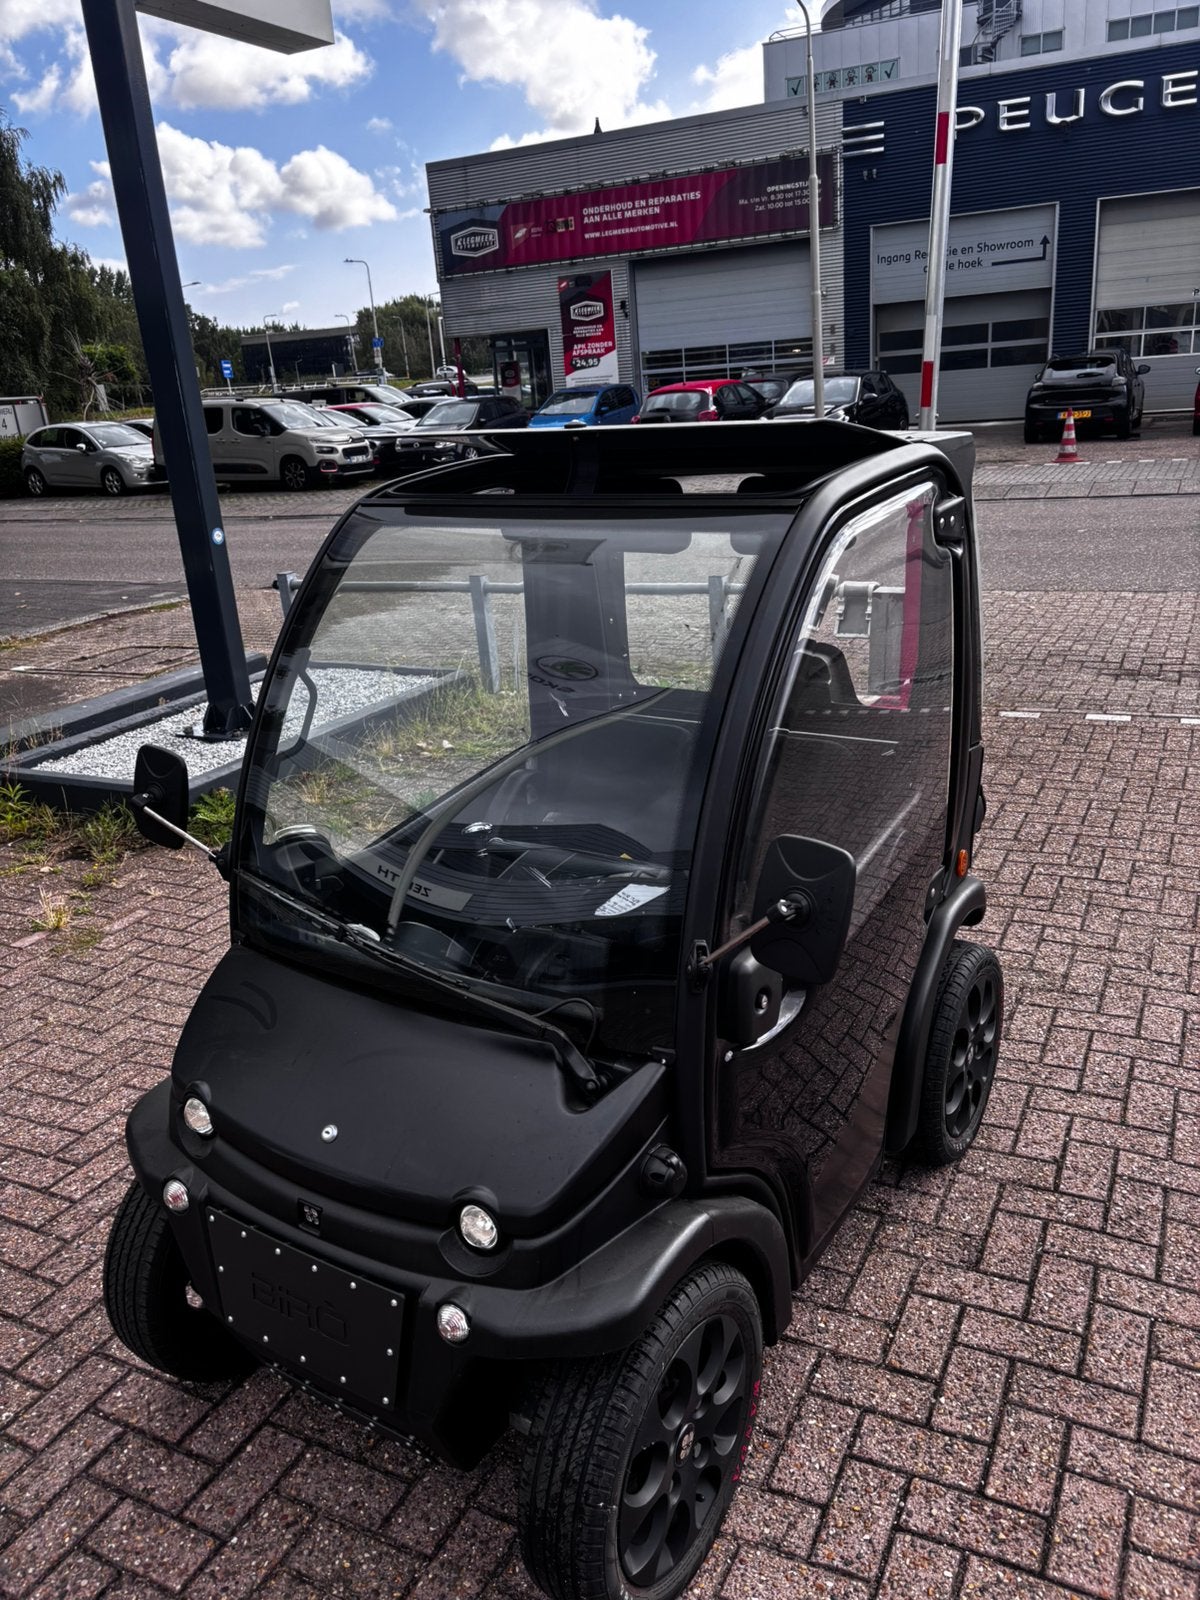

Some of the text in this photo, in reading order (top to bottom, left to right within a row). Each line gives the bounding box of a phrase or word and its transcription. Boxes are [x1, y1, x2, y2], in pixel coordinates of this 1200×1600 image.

[766, 179, 822, 193] OPENINGSTIJN
[583, 191, 701, 216] ONDERHOUD EN REPARATIES
[583, 206, 660, 224] AAN ALLE MERKEN
[584, 221, 678, 239] WWW.LEGMEERAUTOMOTIVE.NL
[877, 238, 1034, 266] Ingang Reie en Showroom
[958, 257, 983, 270] hoek
[572, 347, 605, 356] AFSPRAAK
[587, 341, 613, 349] ZONDER
